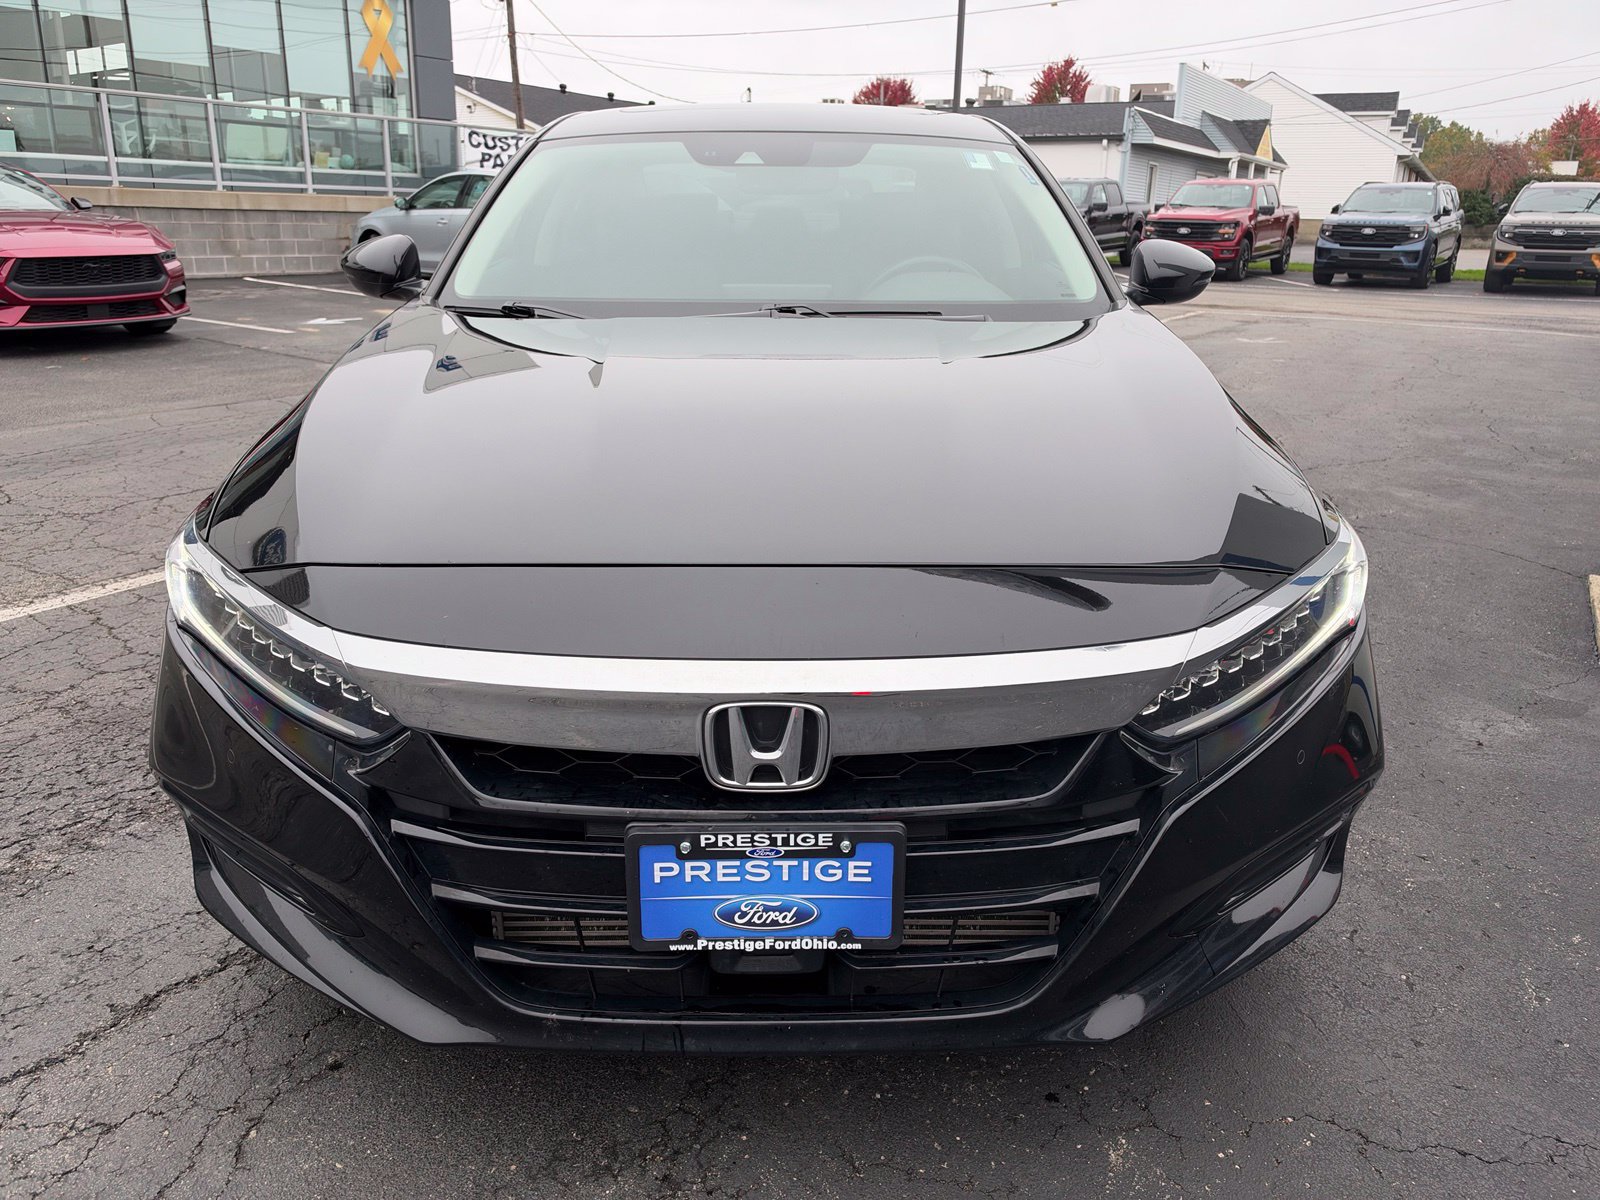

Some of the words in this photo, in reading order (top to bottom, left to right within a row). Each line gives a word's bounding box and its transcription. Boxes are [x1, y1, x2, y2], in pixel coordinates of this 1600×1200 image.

[468, 130, 531, 152] CUST
[479, 152, 513, 168] PA
[700, 833, 833, 847] PRESTIGE
[753, 848, 777, 856] Ford
[653, 861, 873, 884] PRESTIGE
[734, 899, 798, 924] Ford
[669, 938, 862, 952] www.PrestigeFordOhio.com
